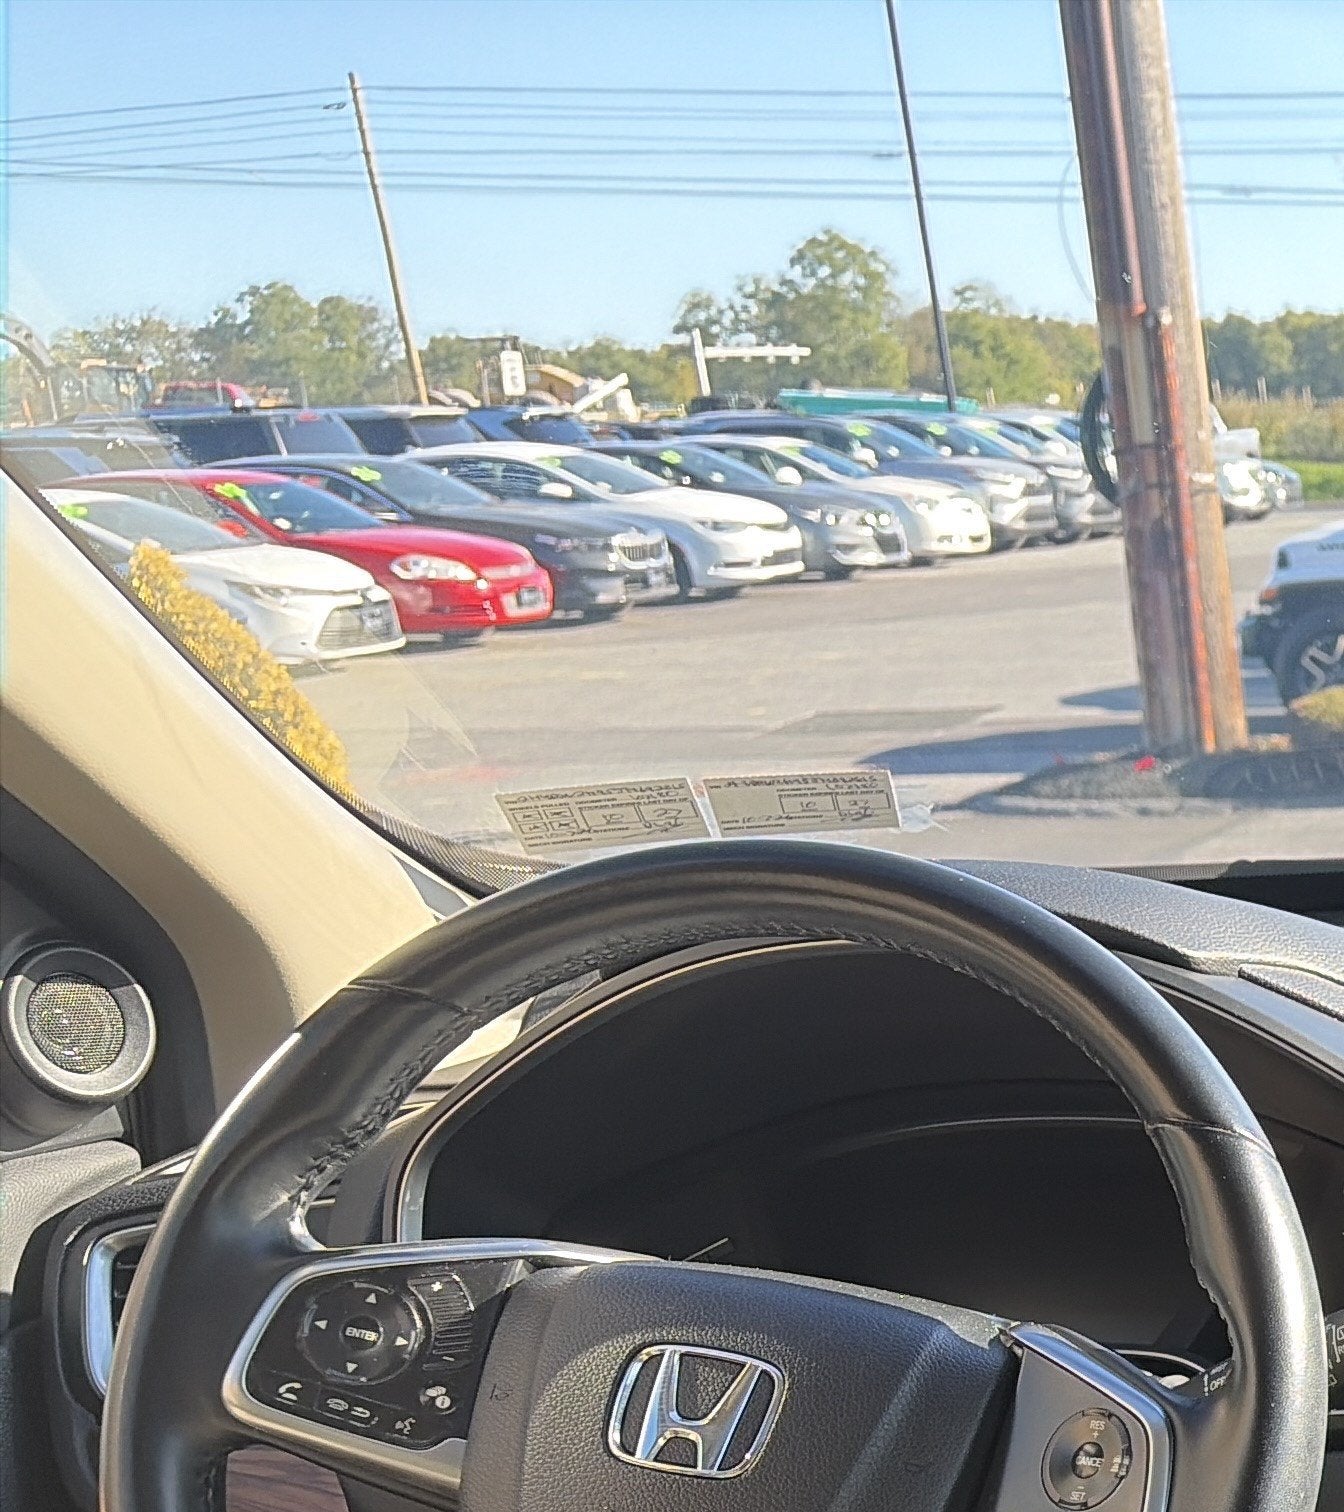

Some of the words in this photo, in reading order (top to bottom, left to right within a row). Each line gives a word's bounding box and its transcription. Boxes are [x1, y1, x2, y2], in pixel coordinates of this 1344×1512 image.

[345, 1326, 380, 1342] ENTER
[1089, 1420, 1106, 1431] RES
[1069, 1491, 1086, 1501] SET
